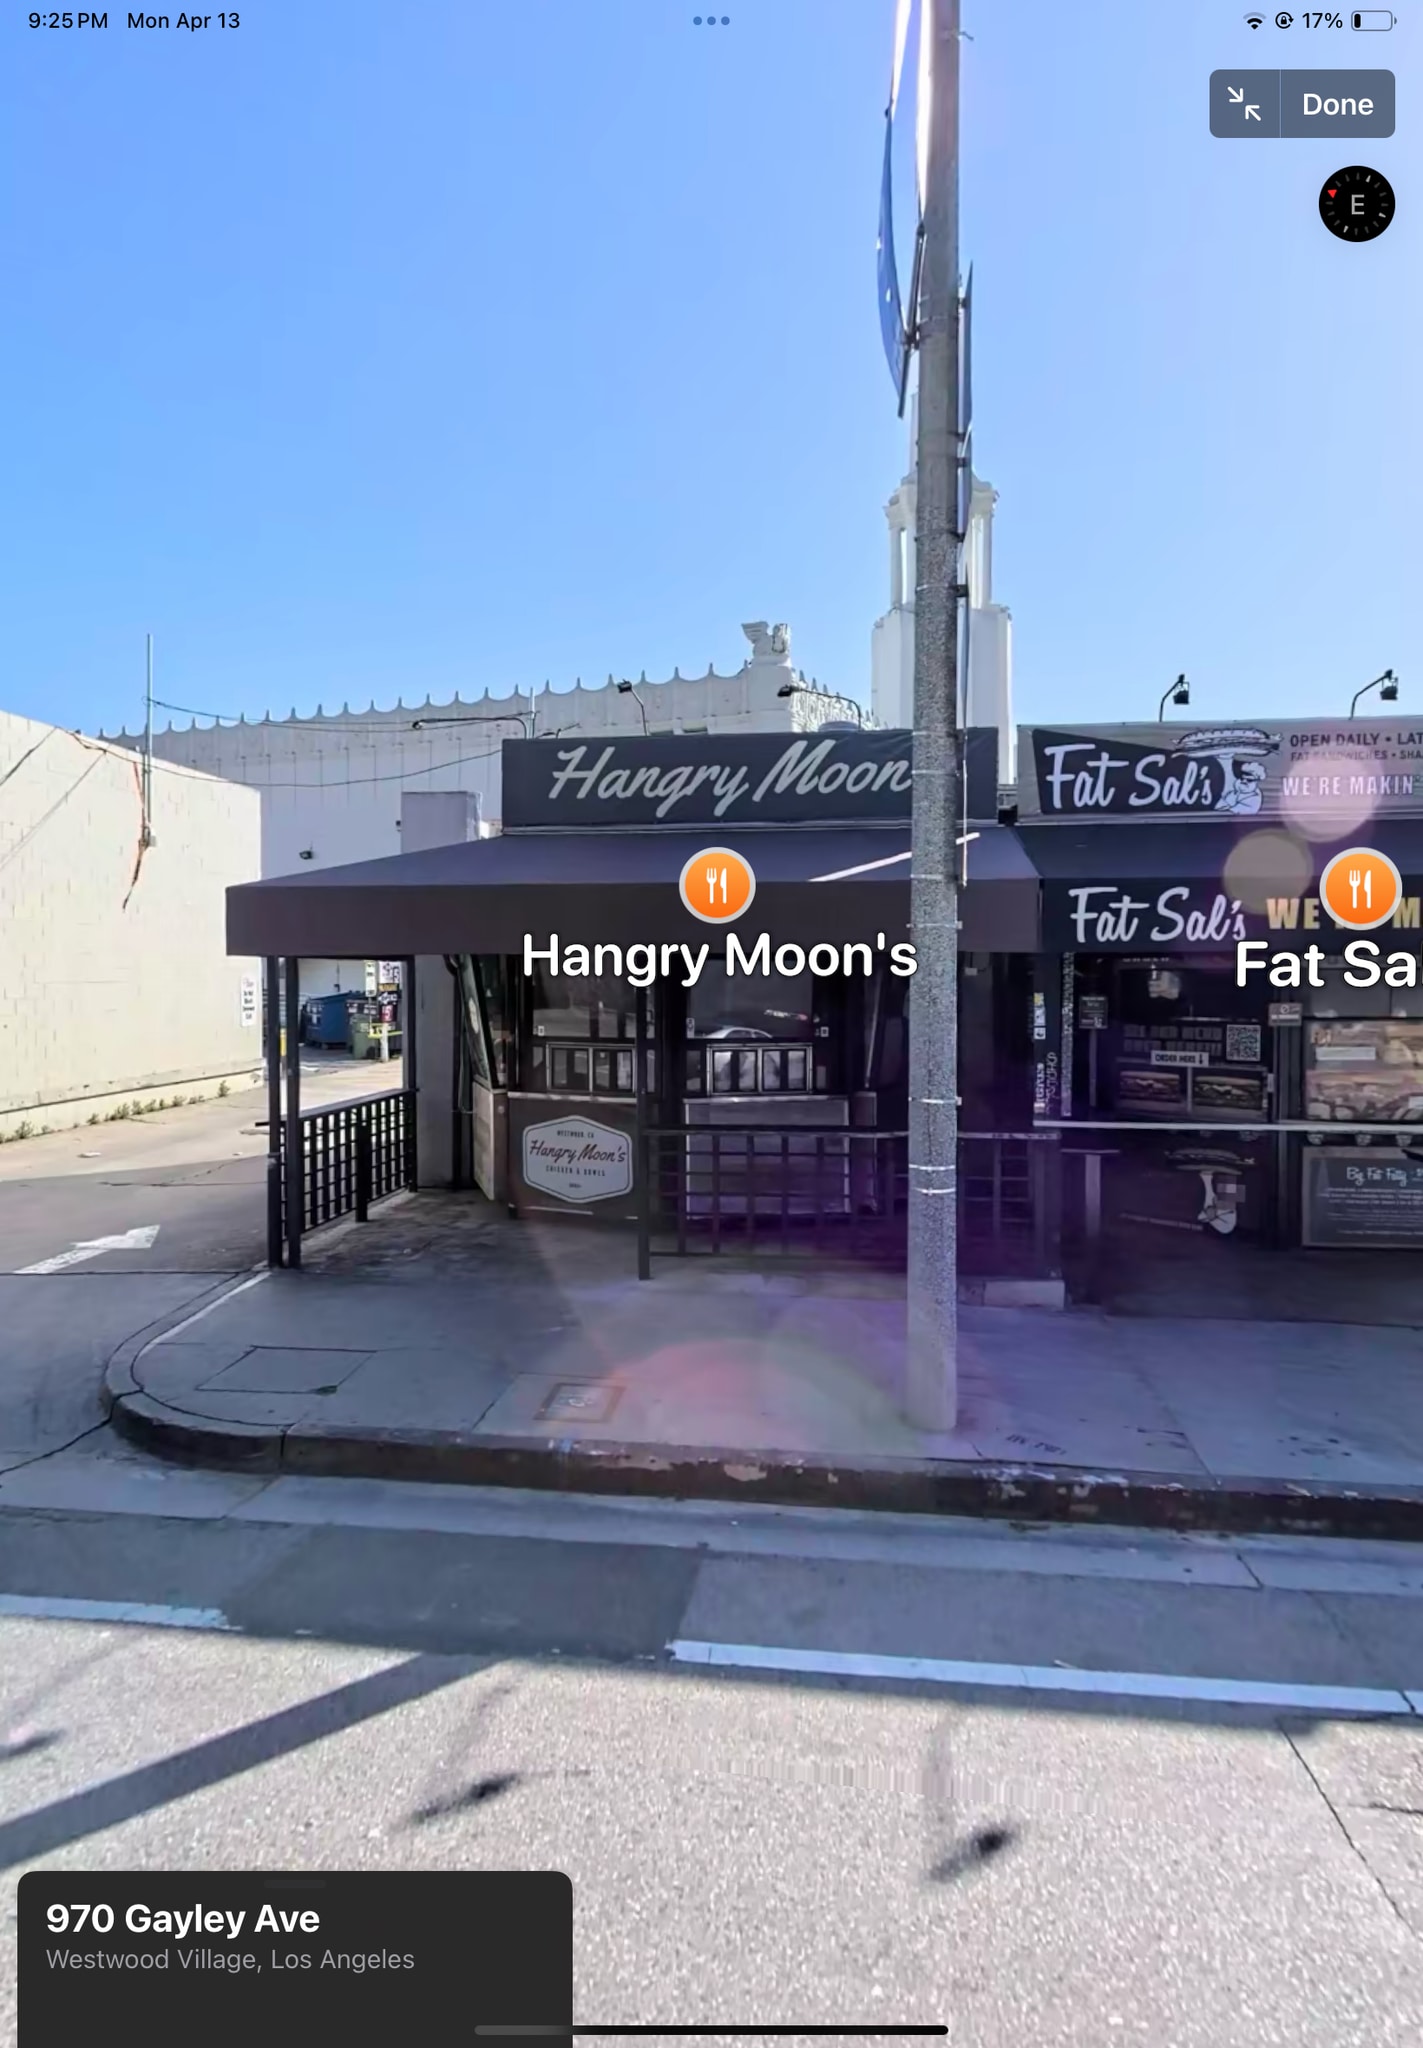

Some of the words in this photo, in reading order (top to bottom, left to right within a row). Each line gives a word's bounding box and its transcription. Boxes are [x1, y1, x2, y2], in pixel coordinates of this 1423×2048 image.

[1290, 734, 1331, 747] OPEN
[1335, 733, 1380, 746] DAILY
[548, 744, 750, 819] Hangry
[1044, 743, 1130, 809] Fat
[1128, 754, 1213, 807] Sal's
[1068, 886, 1150, 943] Fat
[1150, 886, 1247, 941] Sal's
[1154, 1053, 1178, 1063] ORDER
[529, 1140, 577, 1165] Hangry
[577, 1143, 627, 1163] Moon's
